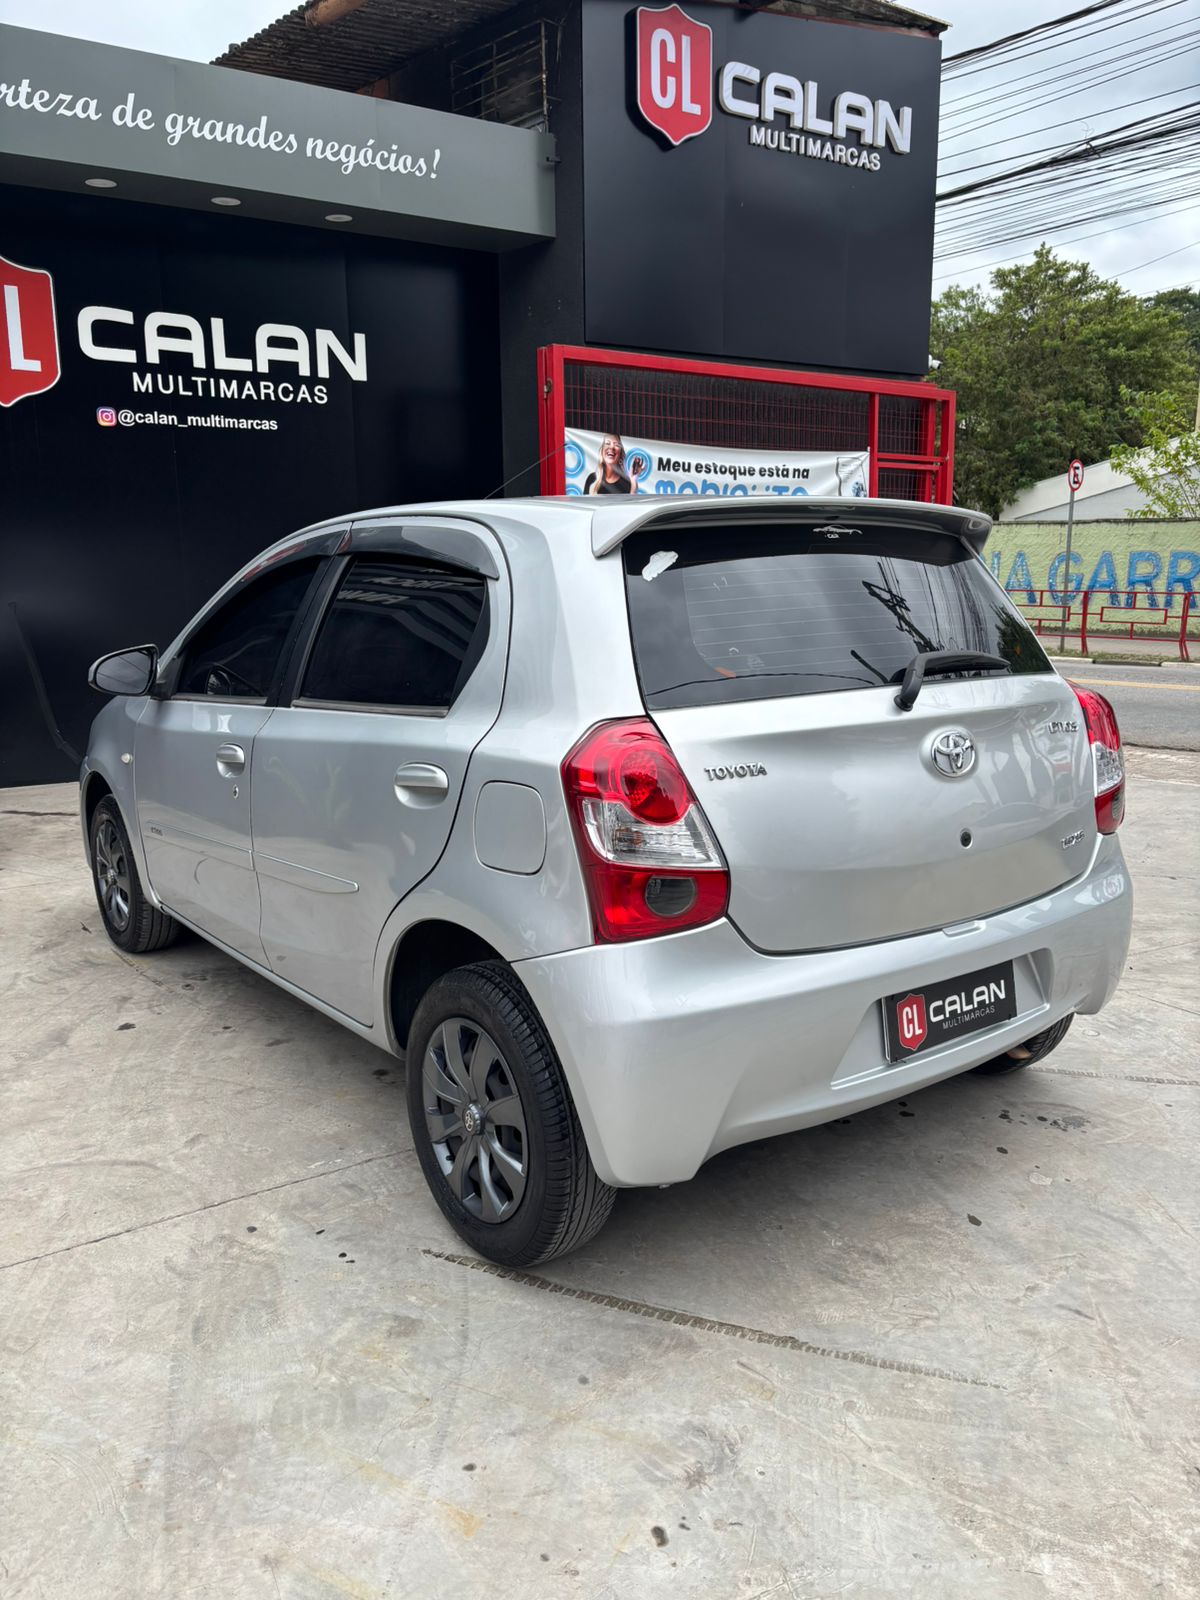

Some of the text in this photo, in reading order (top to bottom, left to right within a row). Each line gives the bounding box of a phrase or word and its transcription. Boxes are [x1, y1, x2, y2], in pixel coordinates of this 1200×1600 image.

[650, 27, 702, 116] CL
[719, 61, 913, 154] CALAN
[112, 92, 155, 130] de
[164, 113, 299, 154] grandes
[305, 138, 441, 179] negócios!
[750, 124, 882, 172] MULTIMARCAS
[77, 305, 368, 382] CALAN
[132, 371, 329, 404] MULTIMARCAS
[117, 408, 279, 431] @calan_multimarcas
[657, 456, 810, 481] Meu estoque está na
[703, 761, 768, 782] TOYOTA
[929, 979, 1006, 1023] CALAN
[942, 1005, 996, 1030] MULTIMARCAS
[902, 1004, 923, 1039] CL
